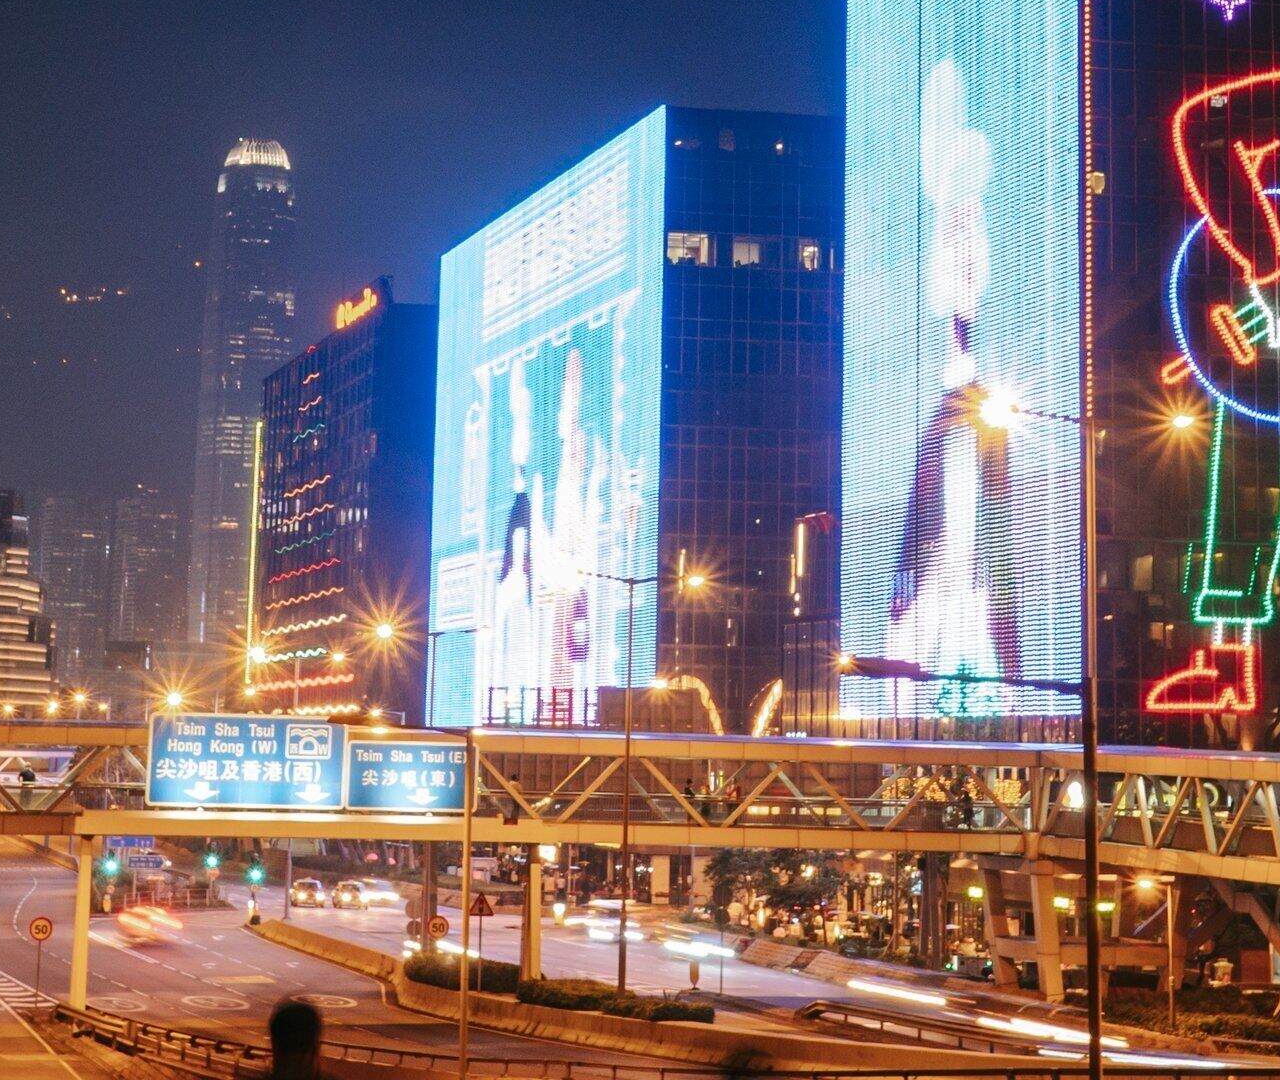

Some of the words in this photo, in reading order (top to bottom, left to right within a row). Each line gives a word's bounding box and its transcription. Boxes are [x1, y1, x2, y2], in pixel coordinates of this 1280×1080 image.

[176, 721, 206, 736] Tsim
[214, 722, 240, 737] Sha
[248, 723, 275, 738] Tsui
[167, 738, 202, 756] Hong
[210, 739, 245, 757] Kong
[251, 740, 278, 755] (W)
[356, 749, 383, 762] Tsim
[390, 749, 413, 763] Sha
[421, 750, 445, 763] Tsui
[448, 751, 467, 764] (E)
[155, 757, 322, 783] 尖沙咀及香港(西)
[361, 769, 456, 789] 尖沙咀(東)
[34, 924, 48, 935] 50
[432, 923, 445, 933] 50
